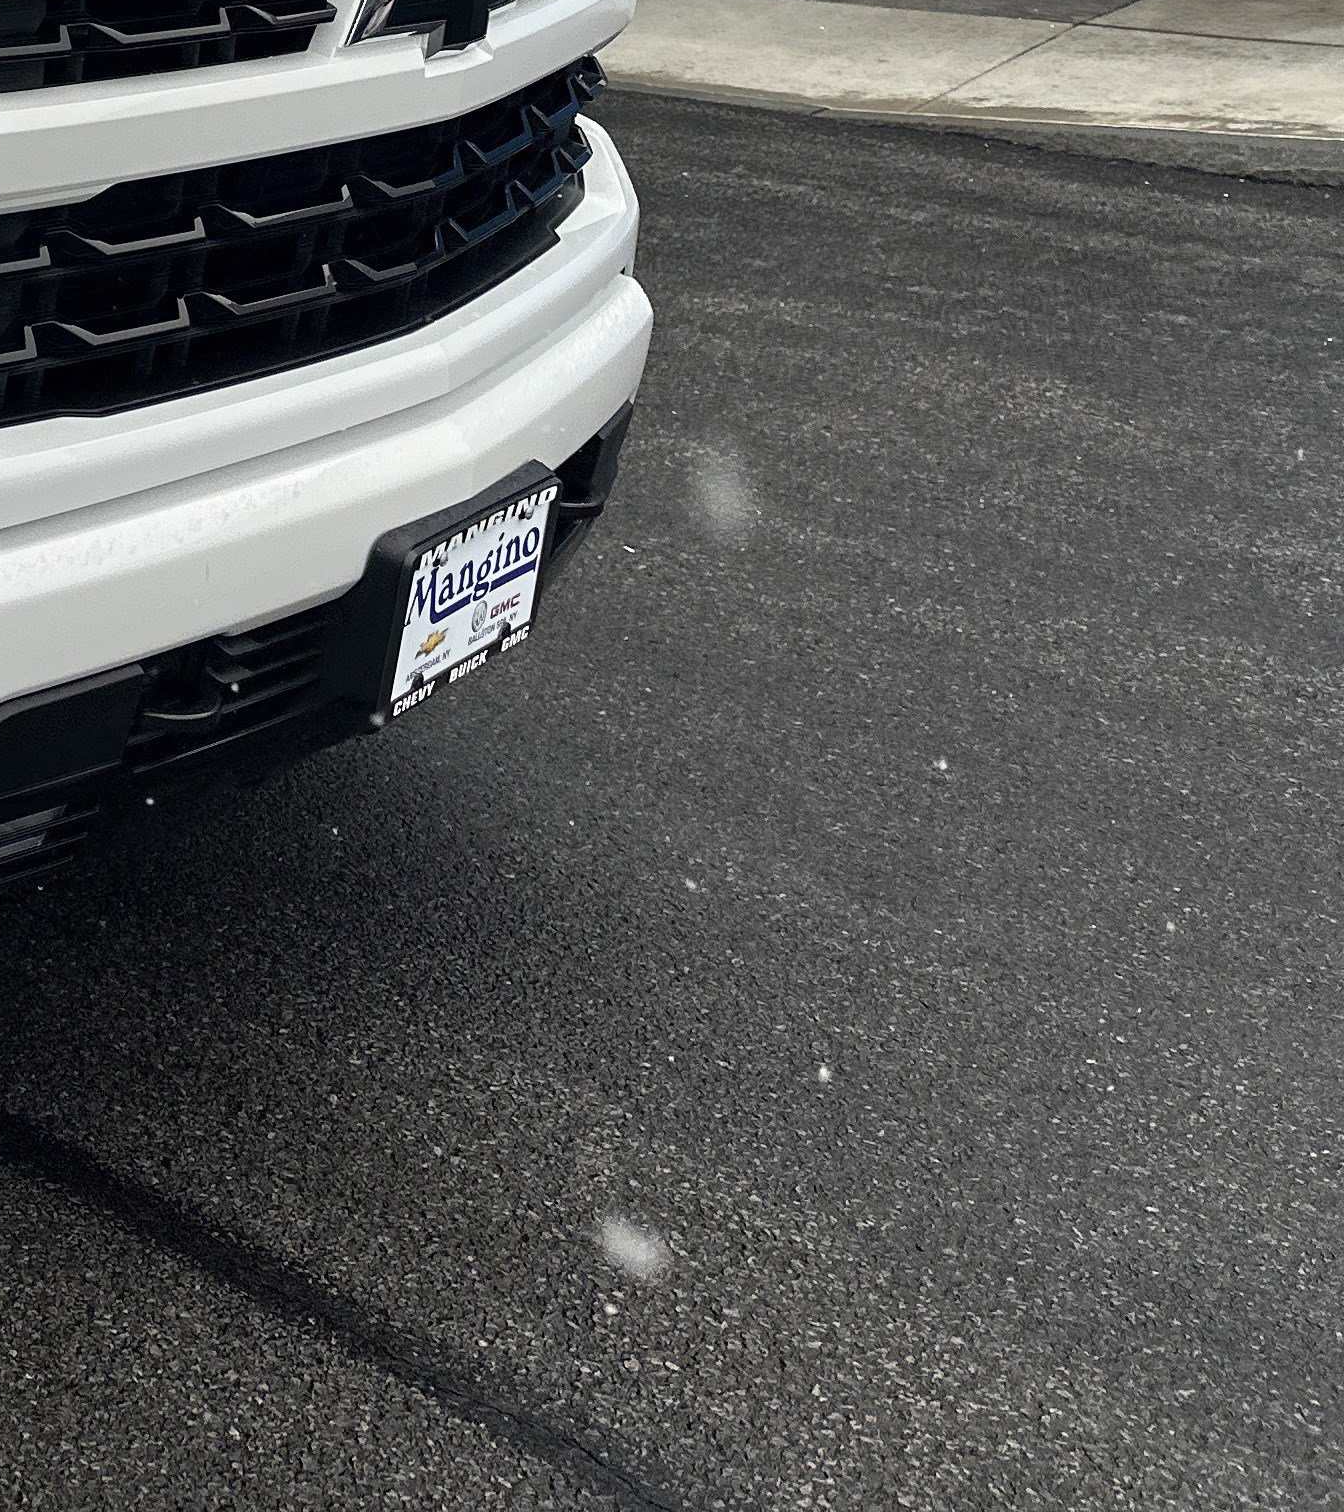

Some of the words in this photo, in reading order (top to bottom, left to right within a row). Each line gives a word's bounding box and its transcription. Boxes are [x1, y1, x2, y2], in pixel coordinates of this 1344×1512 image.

[419, 486, 558, 571] MANGINO
[405, 527, 540, 624] Mangino
[490, 593, 521, 619] GMC
[393, 680, 435, 716] CHEVY
[449, 649, 488, 683] BUICK
[501, 625, 530, 652] GMC
